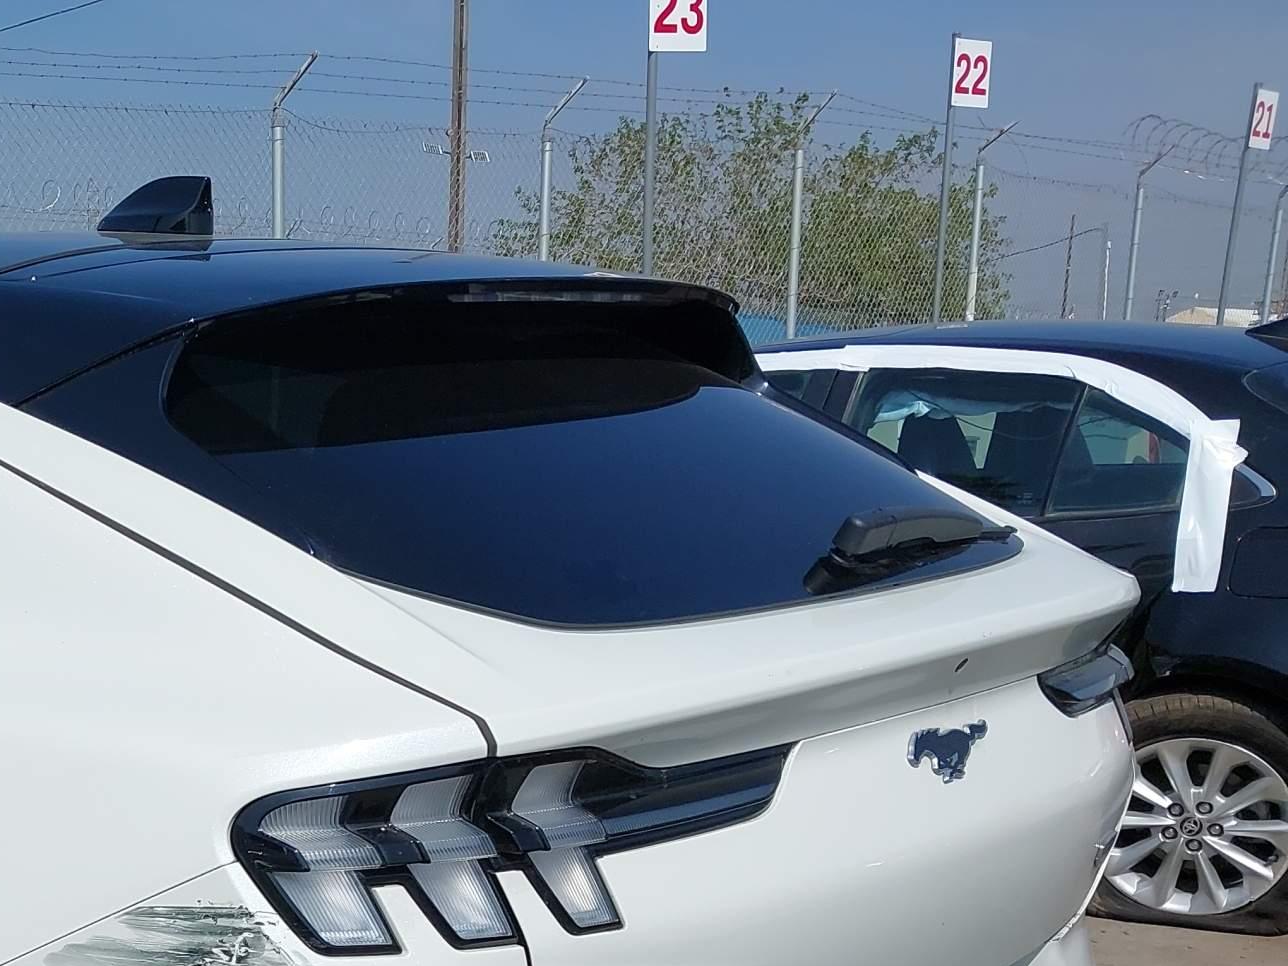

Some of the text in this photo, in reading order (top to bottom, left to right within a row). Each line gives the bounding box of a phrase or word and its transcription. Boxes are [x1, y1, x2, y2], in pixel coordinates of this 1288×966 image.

[654, 0, 704, 35] 23
[955, 53, 988, 96] 22
[1252, 101, 1274, 139] 21
